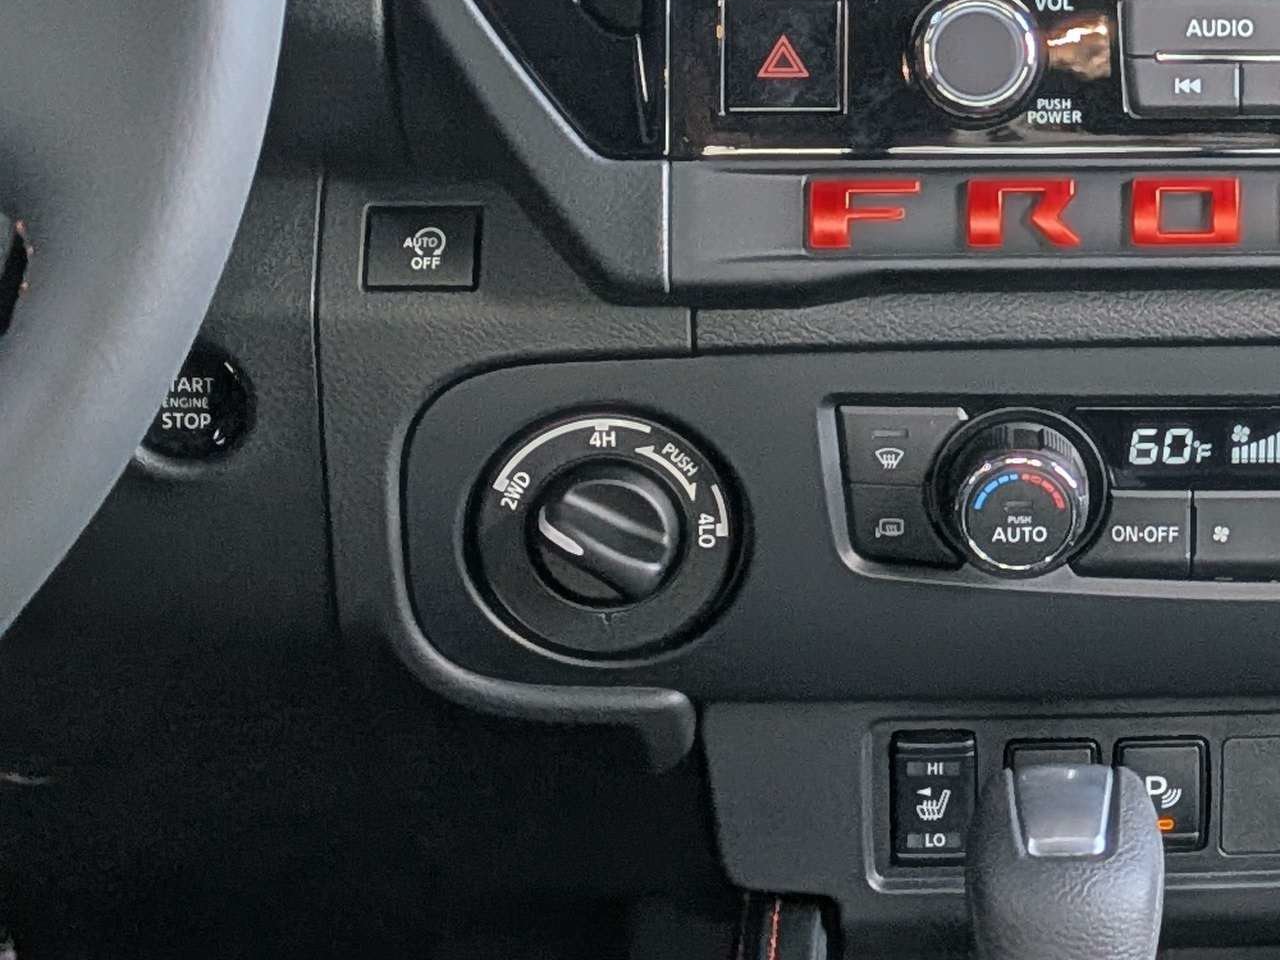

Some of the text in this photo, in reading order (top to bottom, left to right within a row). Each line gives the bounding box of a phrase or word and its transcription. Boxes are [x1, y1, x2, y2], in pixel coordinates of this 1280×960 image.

[1186, 19, 1254, 38] AUDIO
[1037, 99, 1072, 110] PUSH
[1027, 111, 1082, 124] POWER
[403, 237, 438, 248] AUTO
[411, 256, 440, 270] OFF
[168, 376, 215, 394] TART
[161, 413, 212, 430] STOP
[589, 431, 616, 448] 4H
[661, 442, 699, 477] PUSH
[500, 471, 531, 511] 2WD
[1007, 515, 1031, 524] PUSH
[697, 512, 716, 549] 4LO
[991, 526, 1048, 543] AUTO
[927, 762, 944, 776] HI
[925, 833, 945, 847] LO
